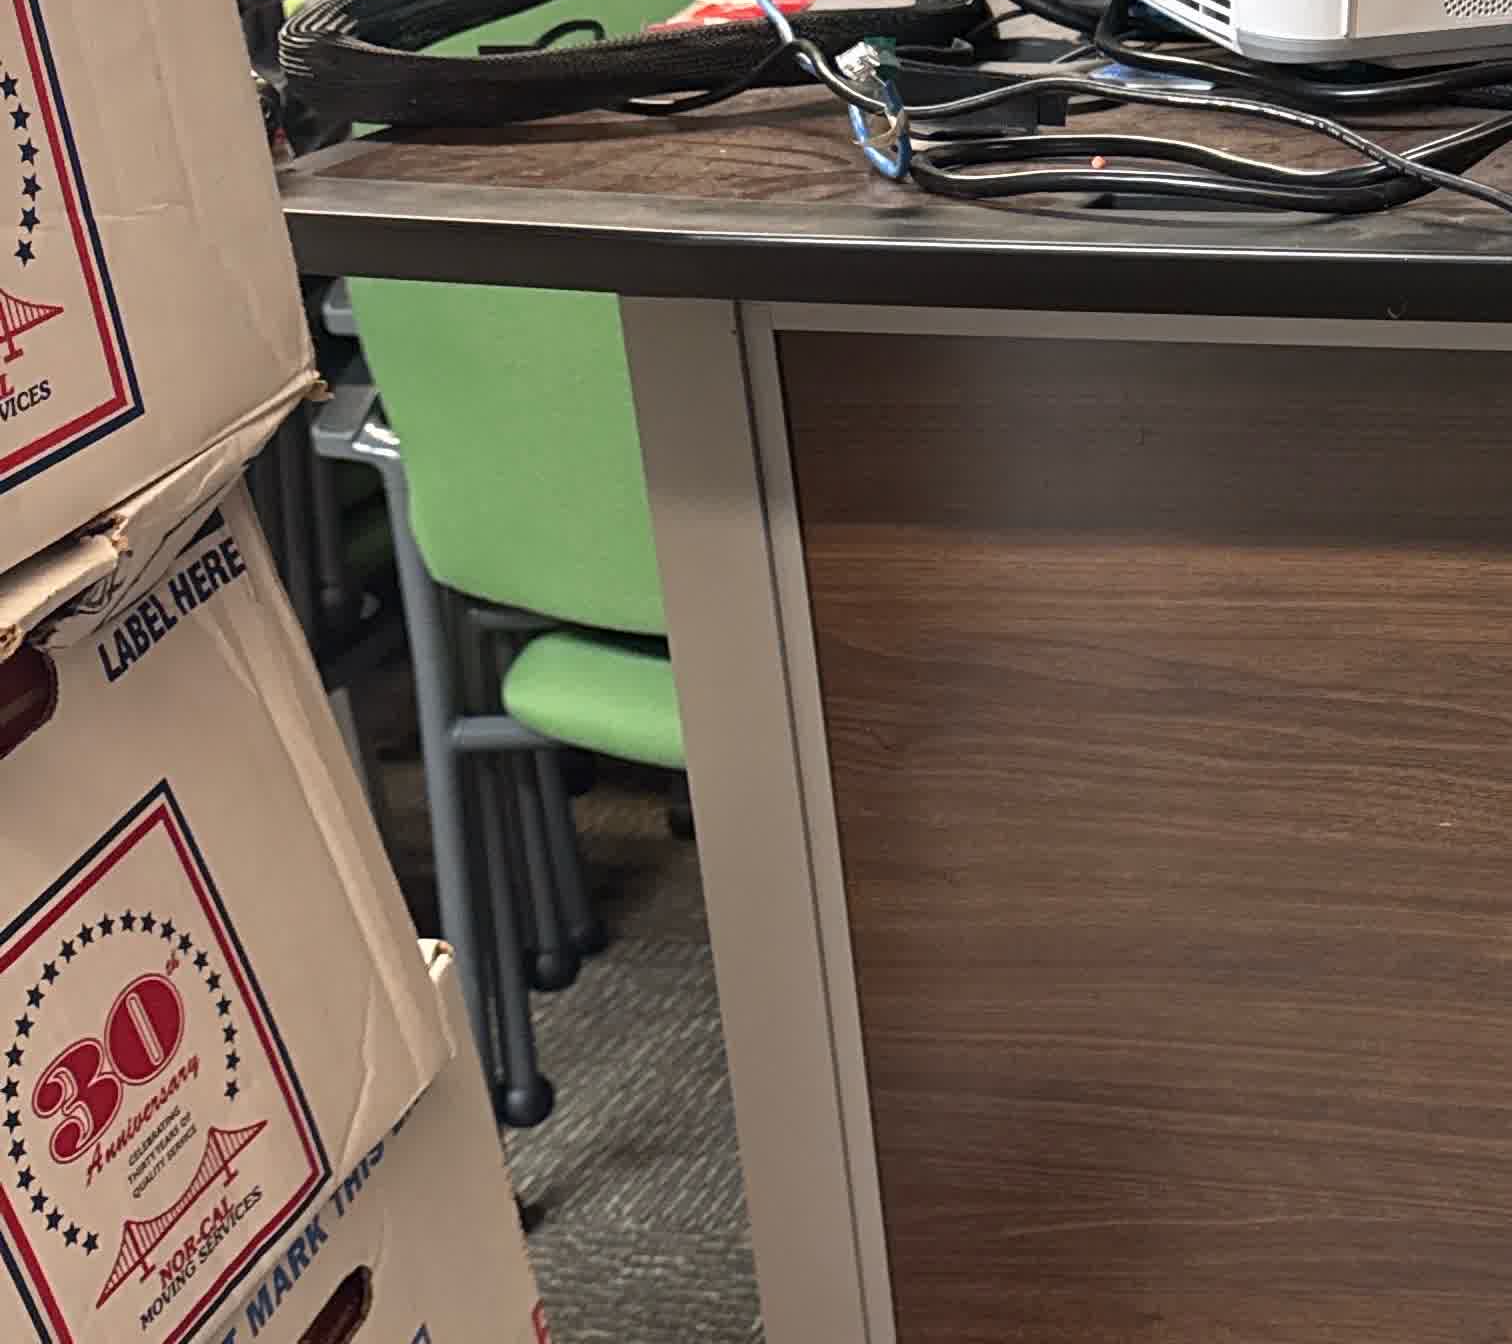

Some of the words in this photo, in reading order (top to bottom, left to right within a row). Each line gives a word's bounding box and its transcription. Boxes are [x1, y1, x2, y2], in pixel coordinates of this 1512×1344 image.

[97, 595, 178, 682] LABEL
[169, 536, 246, 615] HERE
[86, 1054, 199, 1187] Anniversary
[139, 1264, 197, 1332] MOVING
[199, 1185, 263, 1265] SERVICES
[158, 1196, 235, 1290] NOR-CAL
[245, 1214, 329, 1337] MARK
